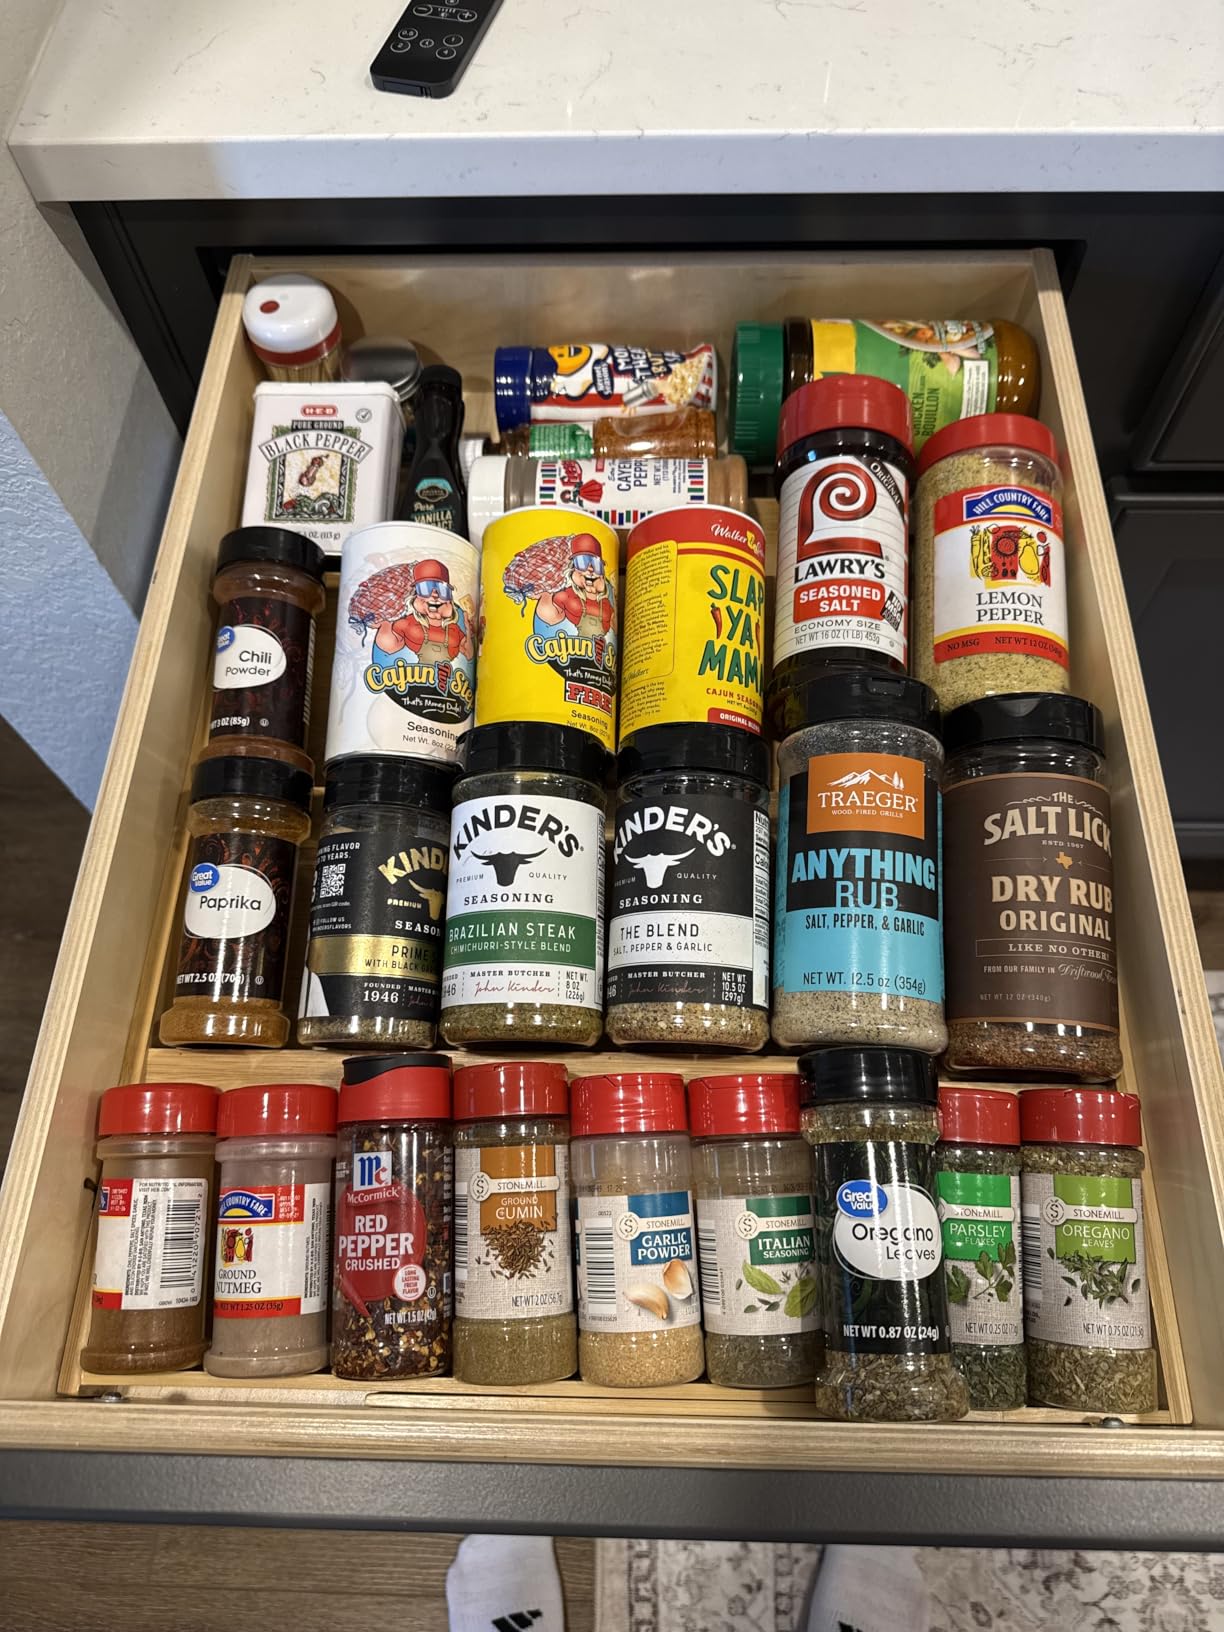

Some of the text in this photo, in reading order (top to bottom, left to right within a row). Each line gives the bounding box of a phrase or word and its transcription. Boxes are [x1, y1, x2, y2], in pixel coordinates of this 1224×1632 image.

[922, 388, 939, 436] BOUILLON
[293, 421, 343, 429] PURE GROUND
[265, 433, 366, 459] BLACK PEPPER
[973, 493, 1049, 521] HILL COUNTRY FARE
[415, 510, 452, 523] VANILLA
[711, 524, 747, 543] Walker
[794, 558, 885, 584] LAWRY'S
[707, 565, 764, 617] SLAP
[800, 585, 880, 603] SEASONED
[819, 600, 861, 612] SALT
[976, 592, 1043, 608] LEMON
[976, 608, 1044, 625] PEPPER
[725, 605, 754, 649] YA
[795, 620, 880, 634] ECONOMY SIZE
[795, 631, 880, 646] NET WT 16 OZ LB) 453g
[947, 636, 1027, 651] NO MSG NET WT
[528, 632, 593, 663] Cajun
[239, 650, 272, 664] Chili
[367, 660, 435, 691] Cajun
[568, 684, 612, 714] FIRE
[706, 688, 734, 698] CAJUN
[230, 717, 250, 727] (85g)
[572, 710, 608, 730] Seasoning
[720, 713, 748, 725] ORIGINAL
[817, 791, 917, 813] TRAEGER
[1051, 791, 1074, 804] THE
[880, 810, 903, 818] GRILLS
[453, 804, 580, 860] KINDER'S
[614, 806, 731, 864] KINDER'S
[983, 806, 1112, 858] SALT LICK
[332, 842, 360, 851] FLAVOR
[378, 846, 448, 885] KIND
[791, 848, 936, 891] ANYTHING
[192, 870, 213, 882] Great
[456, 872, 568, 884] PREMIUM QUALITY
[677, 872, 717, 880] QUALITY
[464, 893, 554, 906] SEASONING
[619, 894, 703, 909] SEASONING
[835, 880, 899, 912] RUB
[992, 875, 1113, 914] DRY RUB
[200, 896, 261, 911] Paprika
[387, 899, 422, 908] PREMIUM
[449, 922, 576, 942] BRAZILIAN STEAK
[805, 914, 925, 937] SALT, PEPPER, & GARLIC
[1000, 909, 1111, 941] ORIGINAL
[620, 924, 699, 941] THE BLEND
[392, 945, 430, 960] PRIME
[541, 942, 571, 953] BLEND
[630, 943, 662, 953] PEPPER
[666, 942, 672, 951] &
[676, 942, 712, 952] GARLIC
[1008, 944, 1043, 952] LIKE
[1049, 944, 1067, 954] NO
[365, 960, 419, 971] WITH BLACK
[983, 965, 1002, 973] FROM
[194, 973, 206, 982] 2.5
[566, 971, 588, 982] NET WT.
[722, 972, 735, 980] NET
[803, 971, 926, 995] NET WT. 12.5 oz (354g)
[572, 982, 580, 990] OZ
[722, 982, 745, 993] 10.5 OZ
[364, 990, 399, 1003] 1946
[566, 991, 585, 1003] (226g)
[722, 991, 743, 1005] (297g)
[347, 1187, 399, 1203] McCormick
[501, 1197, 538, 1206] GROUND
[226, 1196, 250, 1206] COUNTRY
[250, 1200, 268, 1216] FARE
[496, 1206, 543, 1220] CUMIN
[1073, 1209, 1124, 1220] STONEMILL
[355, 1214, 388, 1233] RED
[646, 1218, 685, 1228] STONEMILL
[852, 1223, 933, 1246] Oregano
[950, 1223, 1007, 1238] PARSLEY
[1063, 1224, 1129, 1240] OREGANO
[339, 1232, 415, 1258] PEPPER
[642, 1232, 687, 1247] GARLIC
[758, 1236, 810, 1250] ITALIAN
[965, 1237, 995, 1246] FLAKES
[1083, 1239, 1114, 1248] LEAVES
[638, 1244, 690, 1260] POWDER
[763, 1248, 808, 1258] SEASONING
[886, 1247, 936, 1260] Leaves
[345, 1257, 400, 1271] CRUSHED
[219, 1269, 256, 1279] GROUND
[216, 1282, 261, 1293] NUTMEG
[512, 1296, 534, 1307] NET WT
[843, 1325, 939, 1341] NET WT 0.87 OZ (24g)
[978, 1323, 988, 1334] WT
[1083, 1324, 1107, 1335] NET WT
